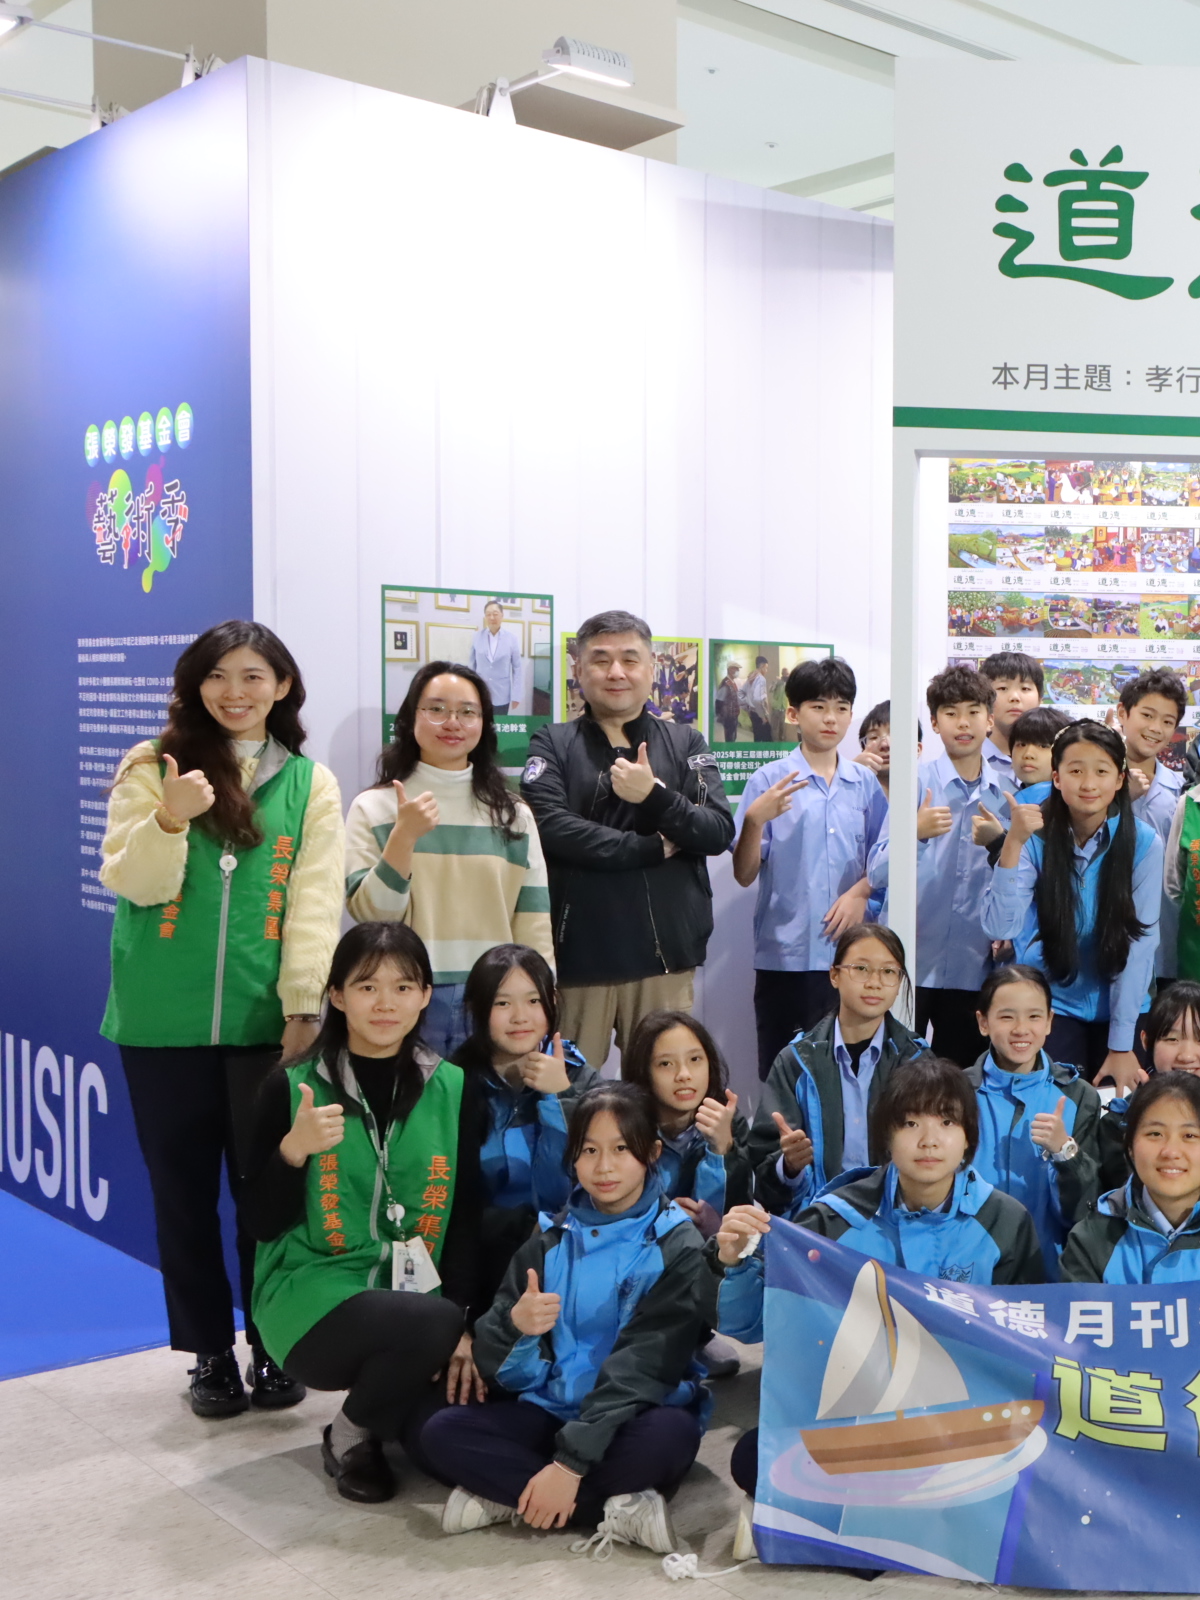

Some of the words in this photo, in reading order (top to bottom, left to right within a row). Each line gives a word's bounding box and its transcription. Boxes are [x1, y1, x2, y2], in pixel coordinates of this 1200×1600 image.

[86, 410, 191, 460] 張榮發基金會
[264, 835, 295, 940] 長榮集團
[0, 1030, 109, 1222] USIC
[319, 1154, 348, 1256] 張榮發基金
